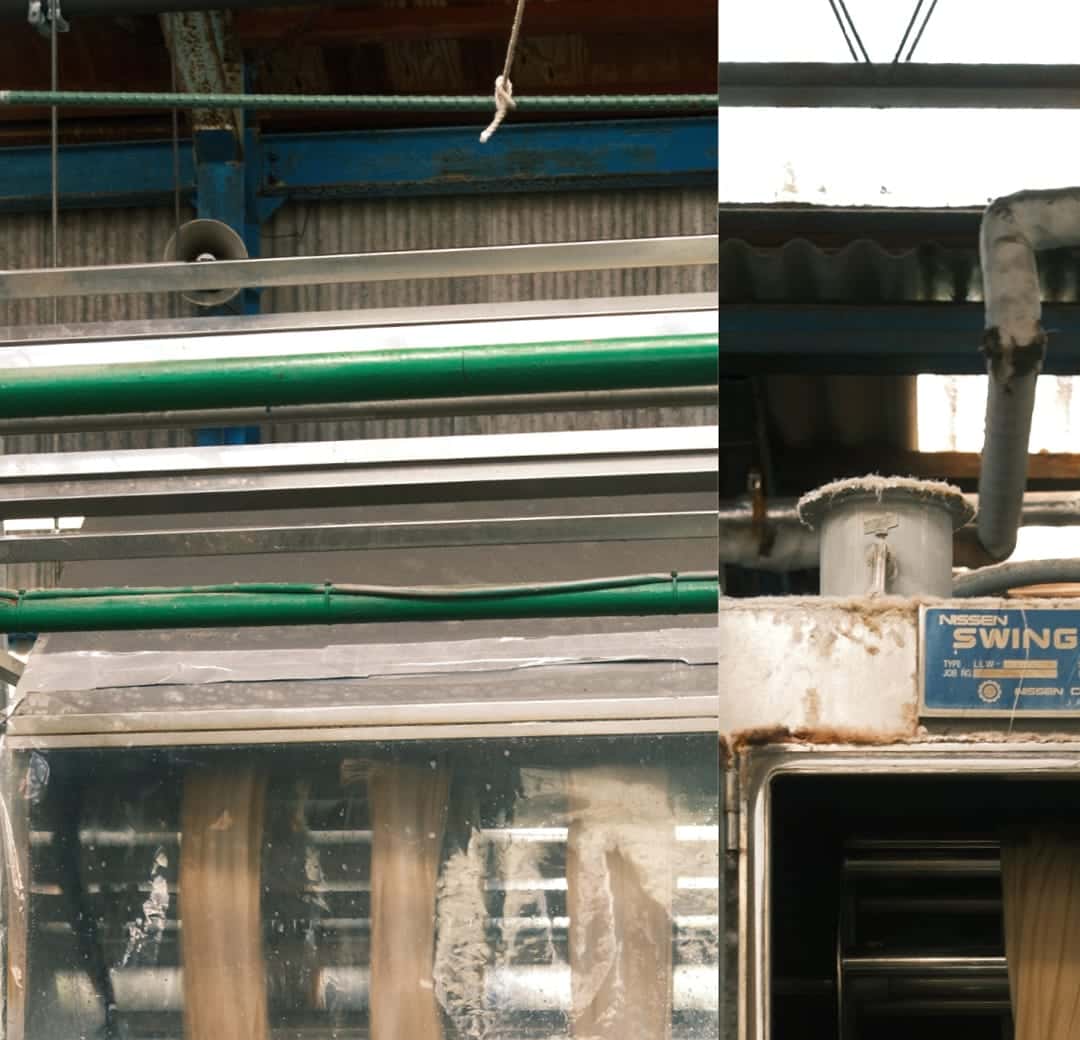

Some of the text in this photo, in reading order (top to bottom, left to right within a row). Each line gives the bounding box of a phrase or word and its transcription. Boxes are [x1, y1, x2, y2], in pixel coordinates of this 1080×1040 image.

[939, 614, 1008, 626] NISSEN
[953, 627, 1078, 649] SWING
[1014, 687, 1064, 696] NISSEN
